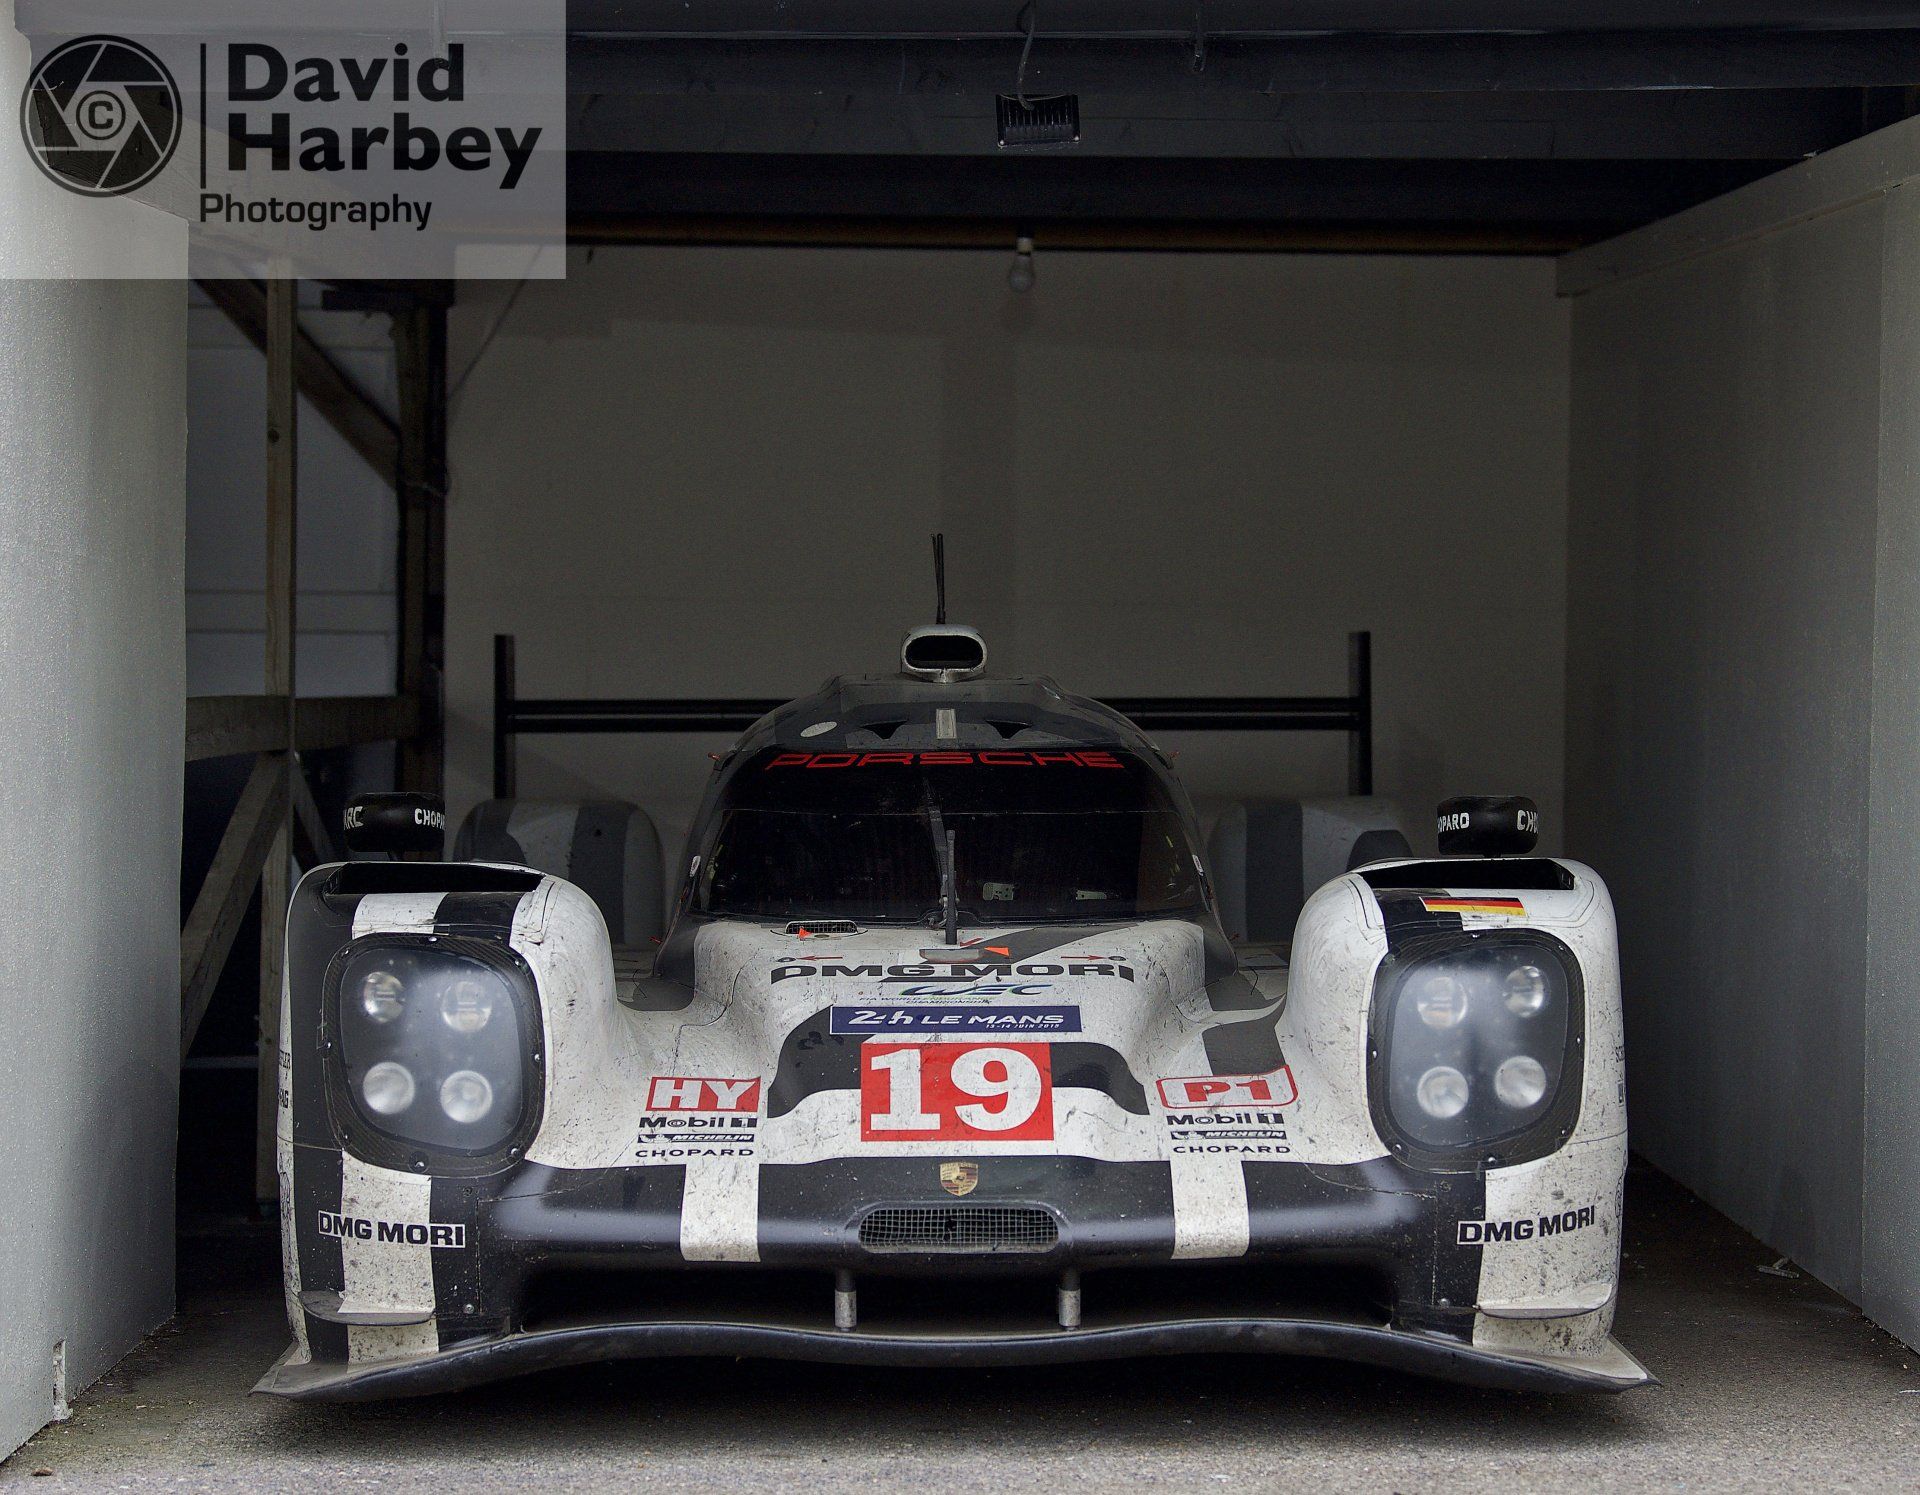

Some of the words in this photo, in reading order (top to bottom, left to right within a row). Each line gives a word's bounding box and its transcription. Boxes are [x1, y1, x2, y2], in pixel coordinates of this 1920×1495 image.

[764, 751, 1124, 770] PORSCHE
[770, 964, 935, 985] DMG
[947, 964, 1135, 984] MORI
[921, 1015, 963, 1025] LE
[967, 1015, 1065, 1024] MANS
[651, 1080, 756, 1109] HY
[870, 1047, 1042, 1131] 19
[1184, 1079, 1272, 1103] P1
[639, 1117, 725, 1128] Mobil
[1166, 1113, 1253, 1125] Mobil
[635, 1149, 754, 1158] CHOPARD
[319, 1212, 372, 1240] DMG
[377, 1221, 464, 1246] MORI
[1458, 1219, 1534, 1242] DMG
[1539, 1205, 1595, 1237] MORI
